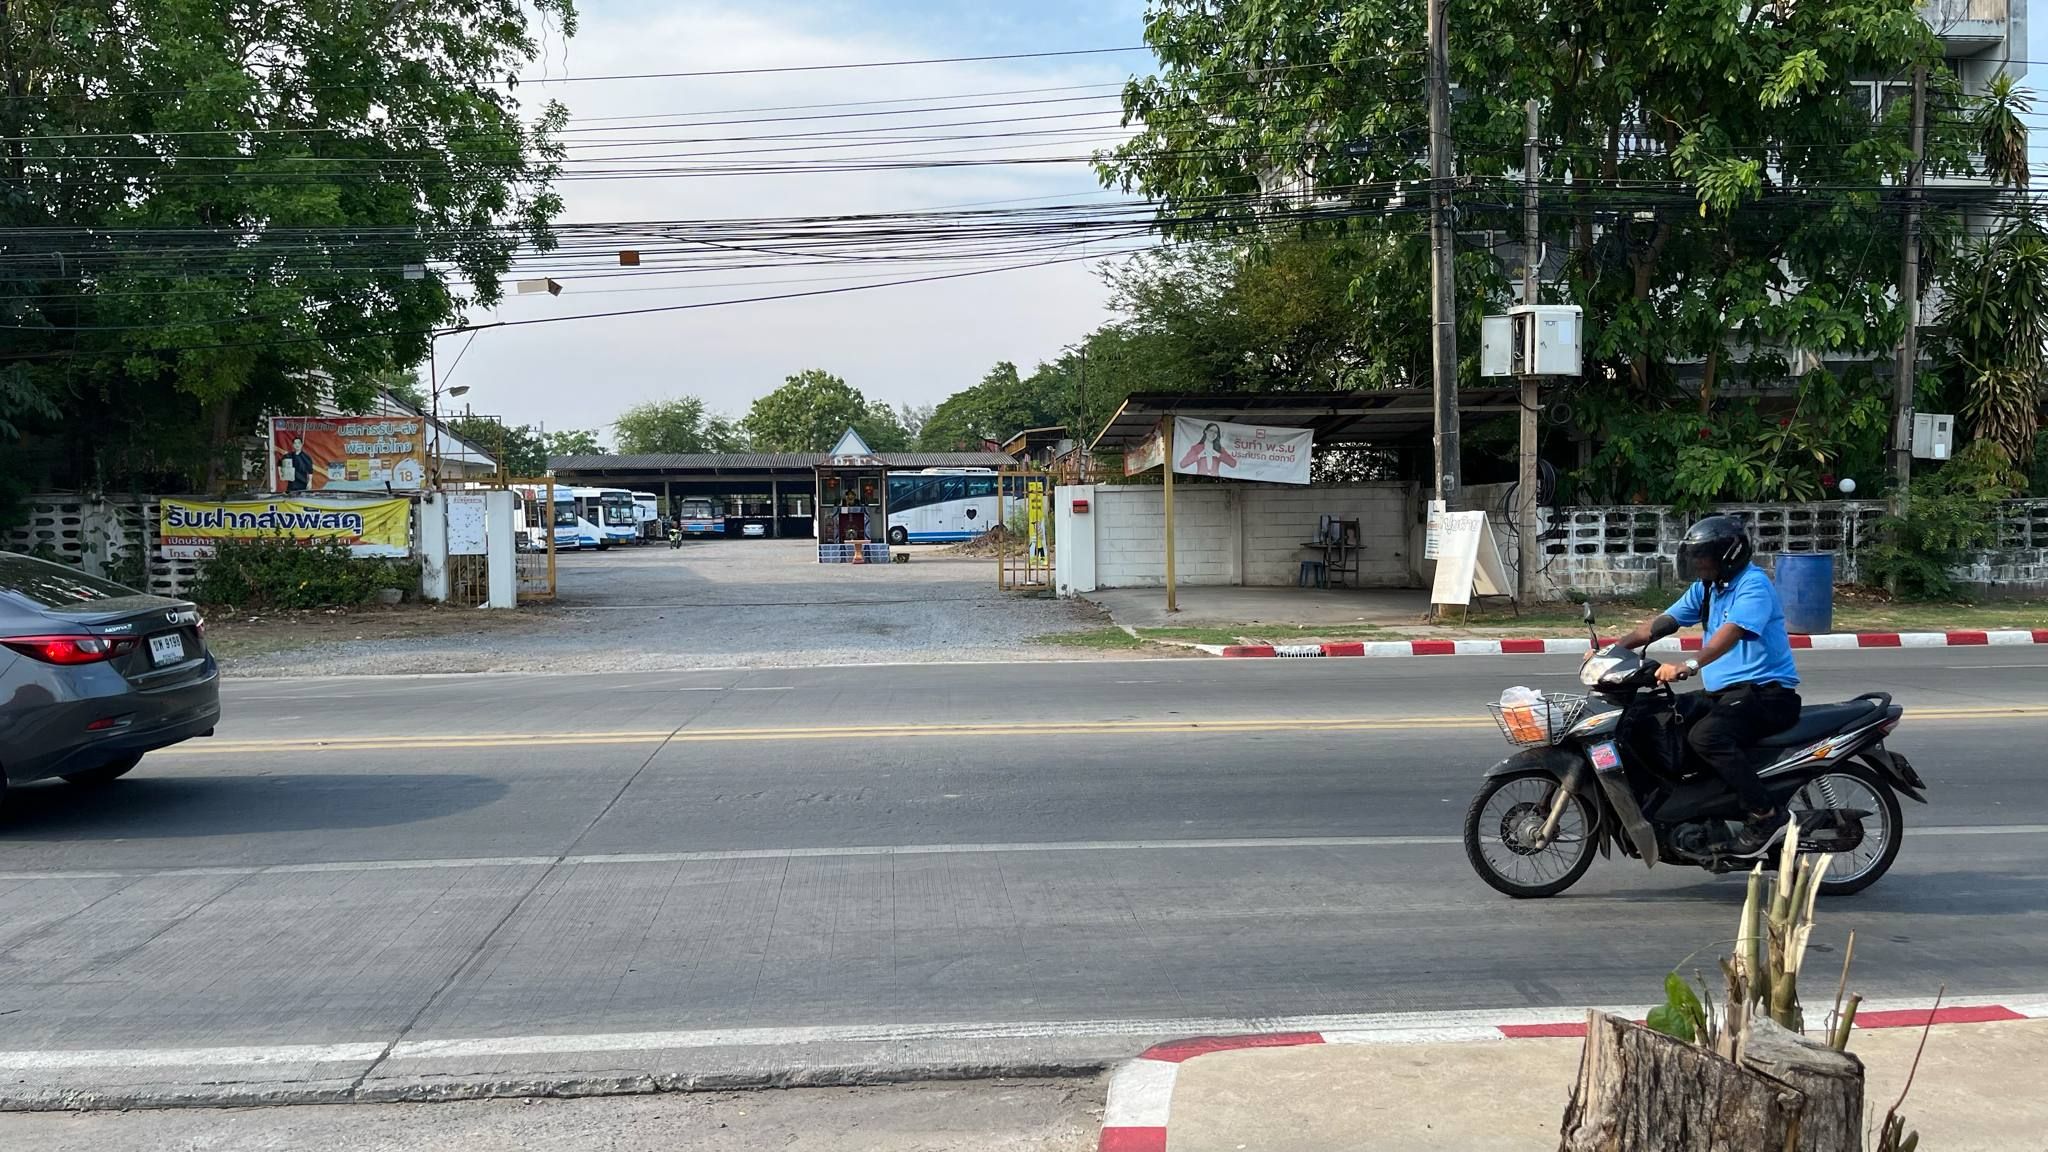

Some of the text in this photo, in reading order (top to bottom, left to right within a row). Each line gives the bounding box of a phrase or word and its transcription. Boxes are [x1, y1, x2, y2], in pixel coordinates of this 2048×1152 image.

[400, 470, 413, 482] 18
[167, 505, 362, 535] รับฝากส่งพัสดุ
